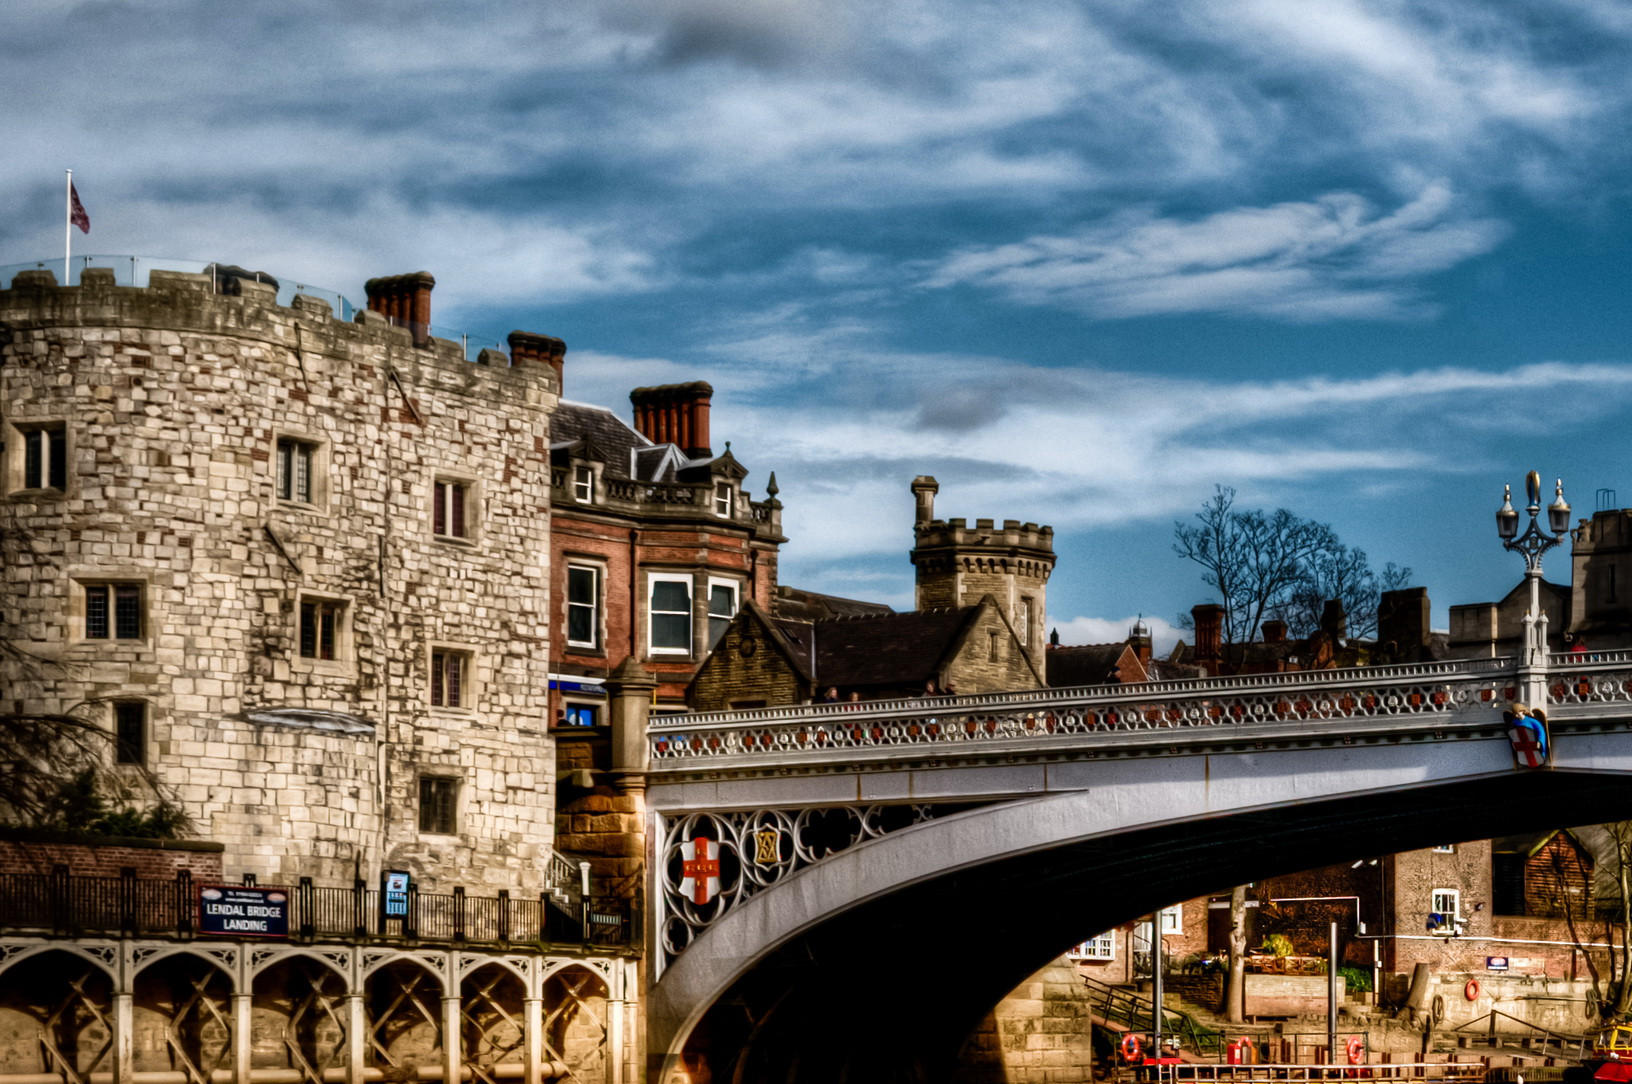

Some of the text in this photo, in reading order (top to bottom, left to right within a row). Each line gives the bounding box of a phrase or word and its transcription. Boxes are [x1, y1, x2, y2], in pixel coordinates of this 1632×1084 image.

[206, 903, 281, 918] LENDAL BRIDGE
[223, 919, 267, 931] LANDING
